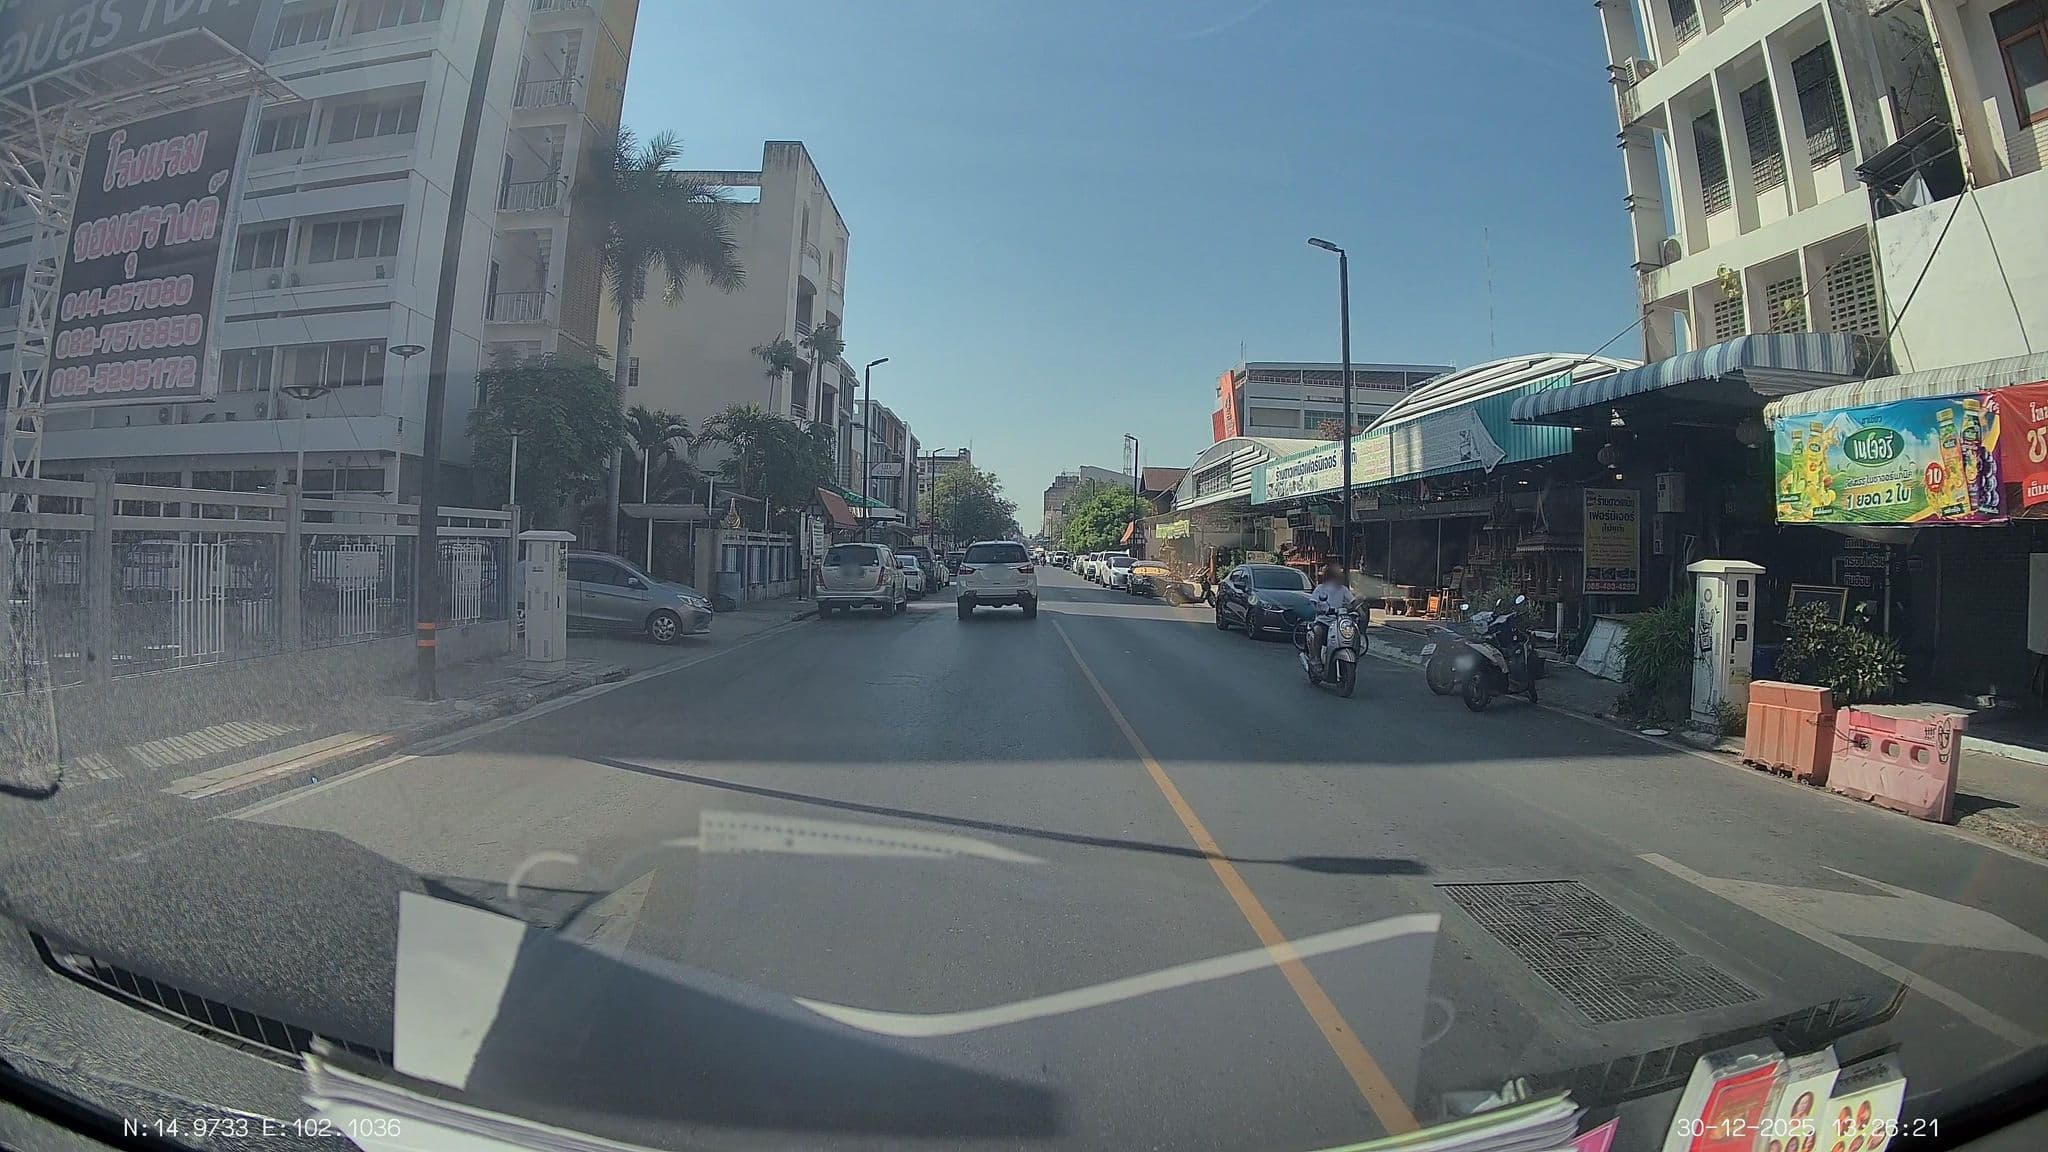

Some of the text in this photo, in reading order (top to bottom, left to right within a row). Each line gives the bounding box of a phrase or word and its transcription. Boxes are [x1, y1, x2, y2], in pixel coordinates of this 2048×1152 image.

[103, 130, 208, 192] โรงแรม
[61, 275, 194, 322] 044-257080
[55, 314, 204, 360] 082-7578850
[50, 355, 198, 398] 082-5295172
[1847, 483, 1910, 509] 1 ยอด 2 ใบ
[1927, 468, 1942, 485] 10
